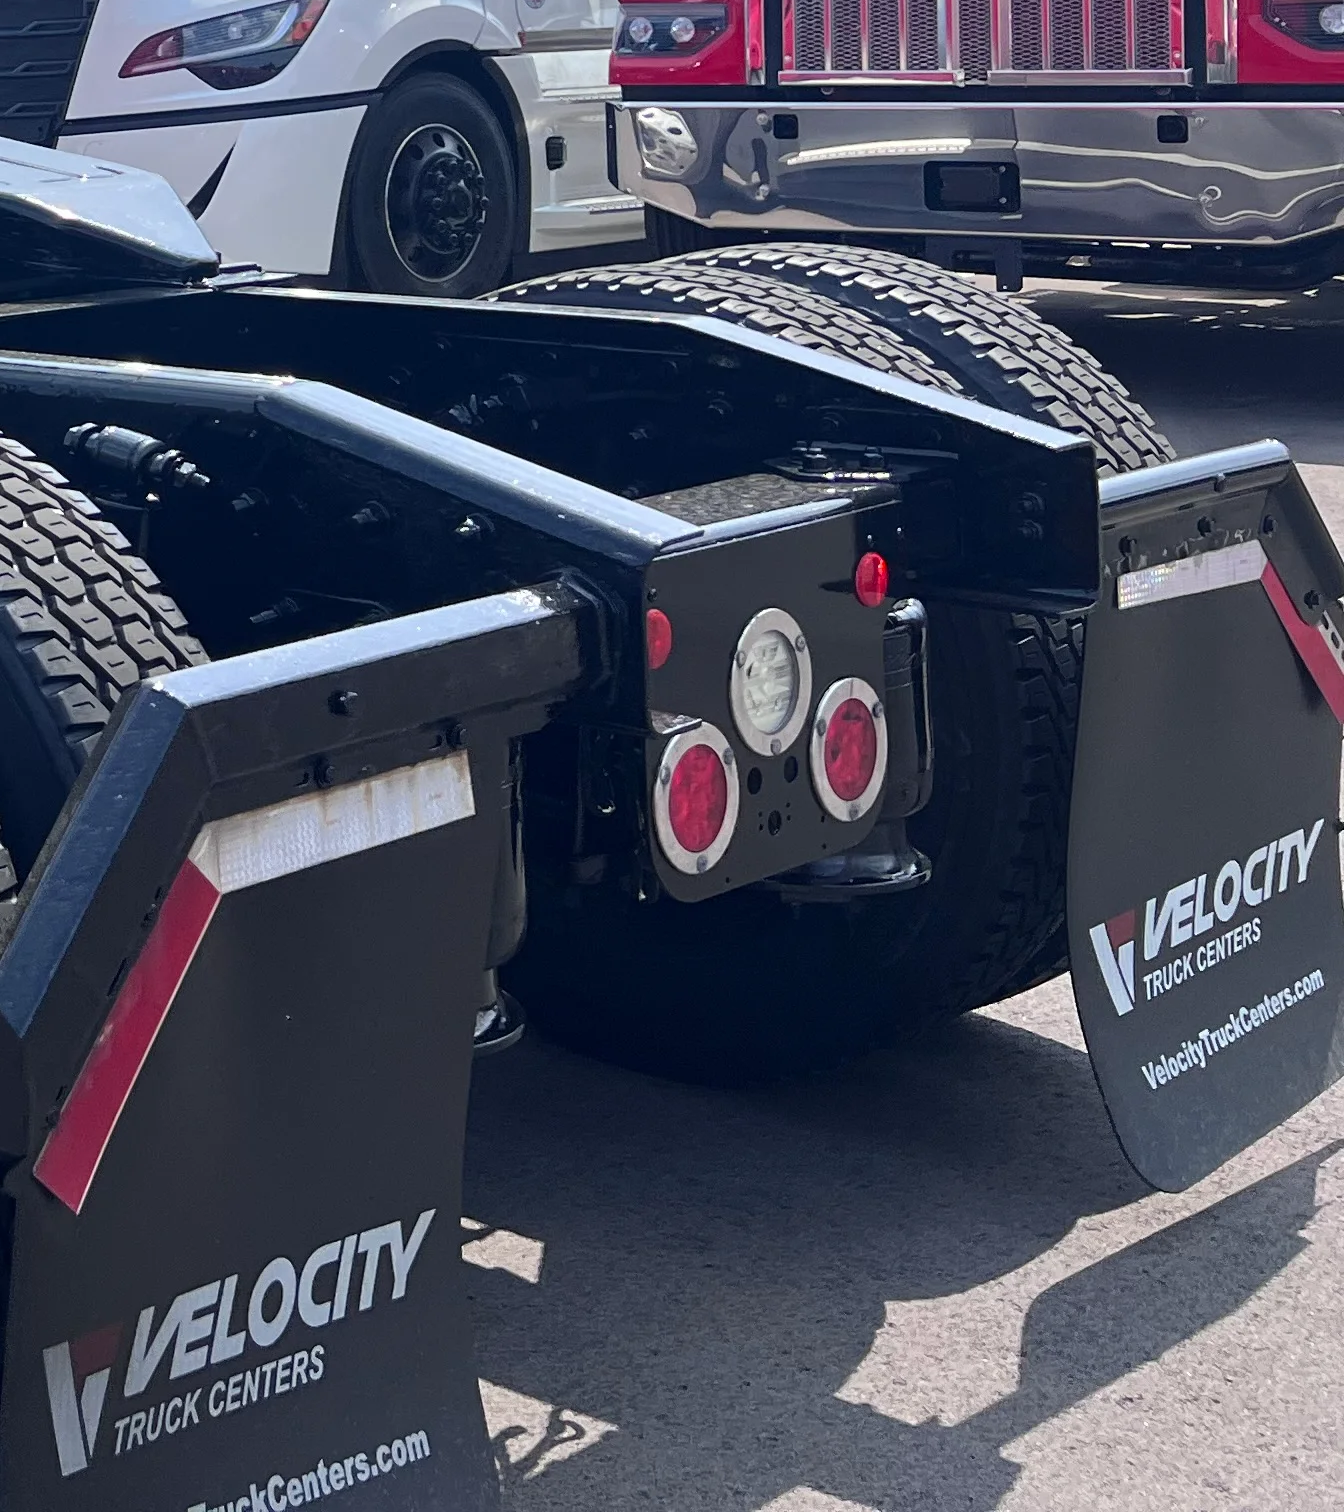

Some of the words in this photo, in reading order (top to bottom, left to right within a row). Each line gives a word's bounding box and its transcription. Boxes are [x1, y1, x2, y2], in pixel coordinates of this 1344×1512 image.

[1143, 818, 1325, 961] VELOCITY
[1142, 952, 1194, 1001] TRUCK
[1196, 917, 1263, 973] CENTERS
[1141, 967, 1325, 1090] VelocityTruckCenters.com
[124, 1208, 437, 1398] VELOCITY
[113, 1387, 203, 1457] TRUCK
[208, 1343, 325, 1419] CENTERS
